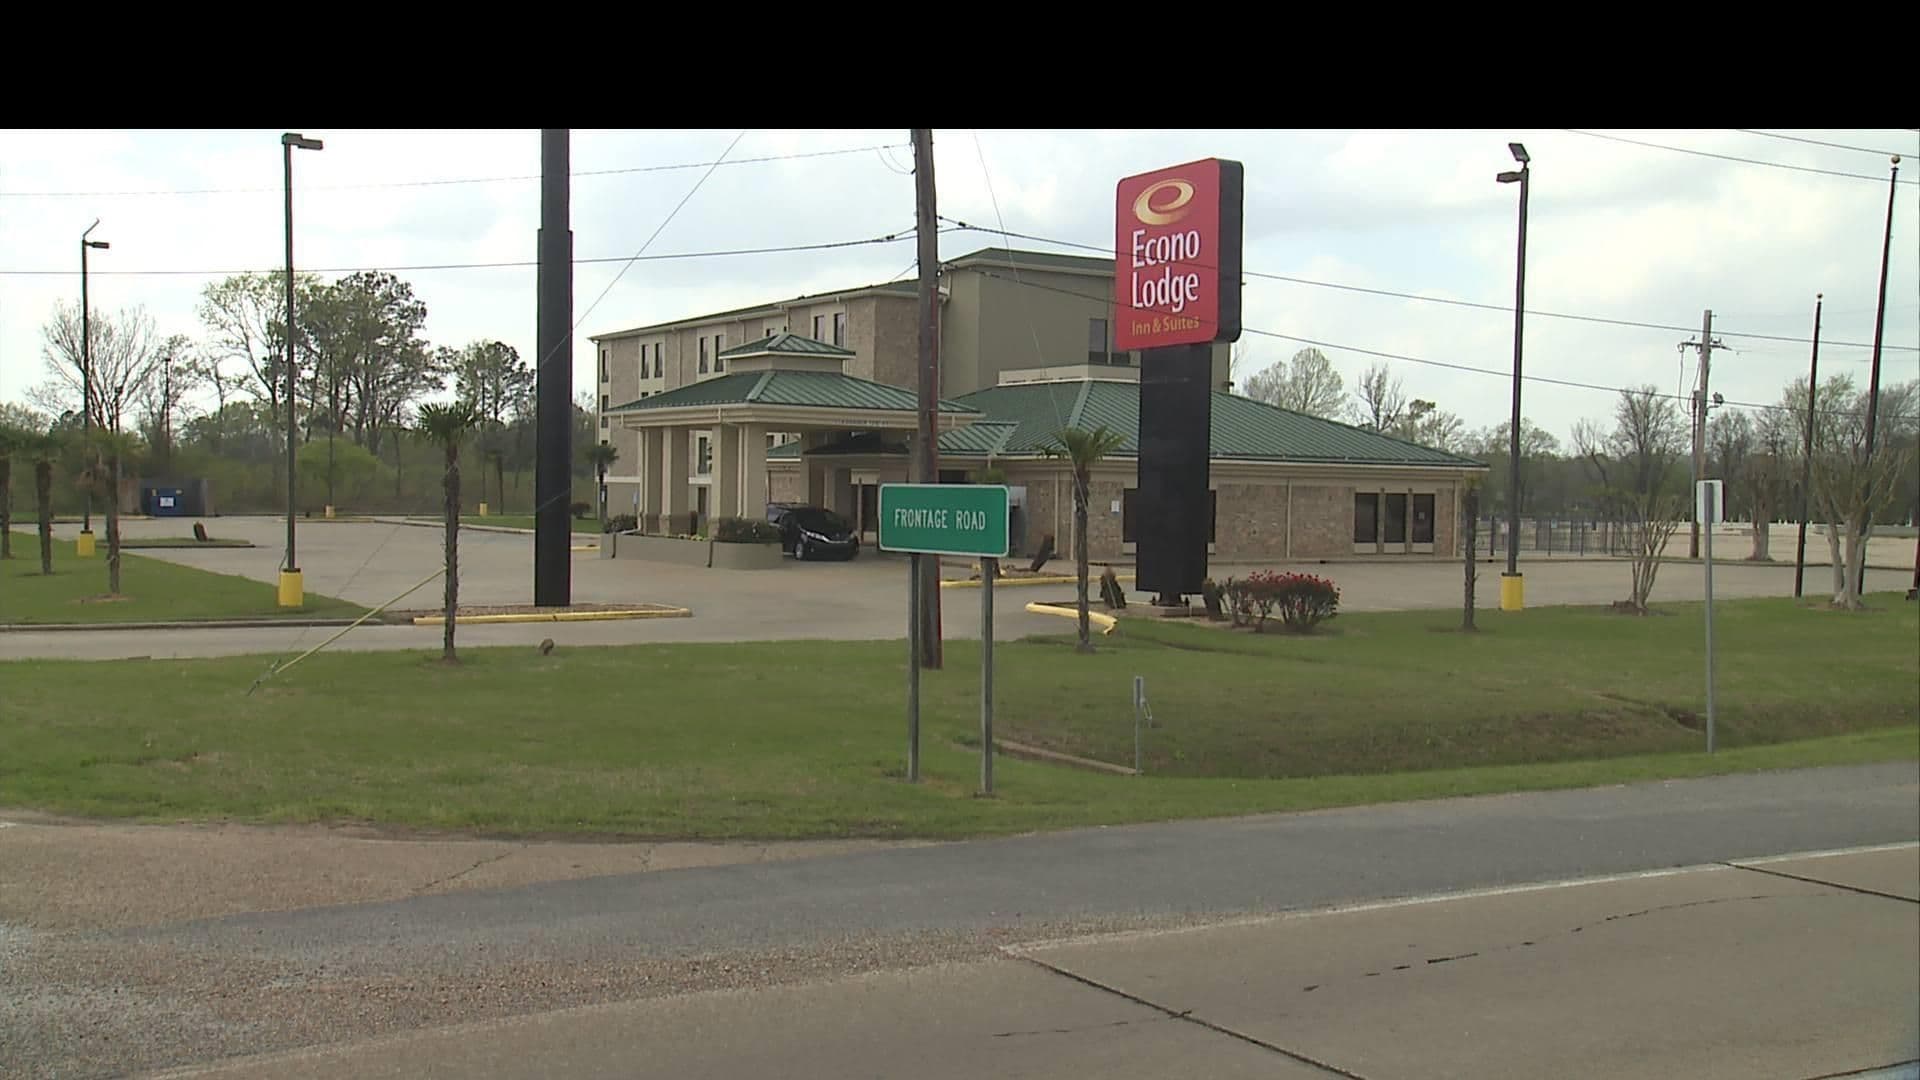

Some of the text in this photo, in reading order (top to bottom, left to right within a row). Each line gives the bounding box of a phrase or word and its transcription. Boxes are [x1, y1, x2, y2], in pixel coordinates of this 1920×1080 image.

[1132, 229, 1200, 268] Econo
[1132, 266, 1199, 313] Lodge
[1132, 316, 1200, 336] Inn & Suites
[894, 508, 986, 530] FRONTAGE ROAD
